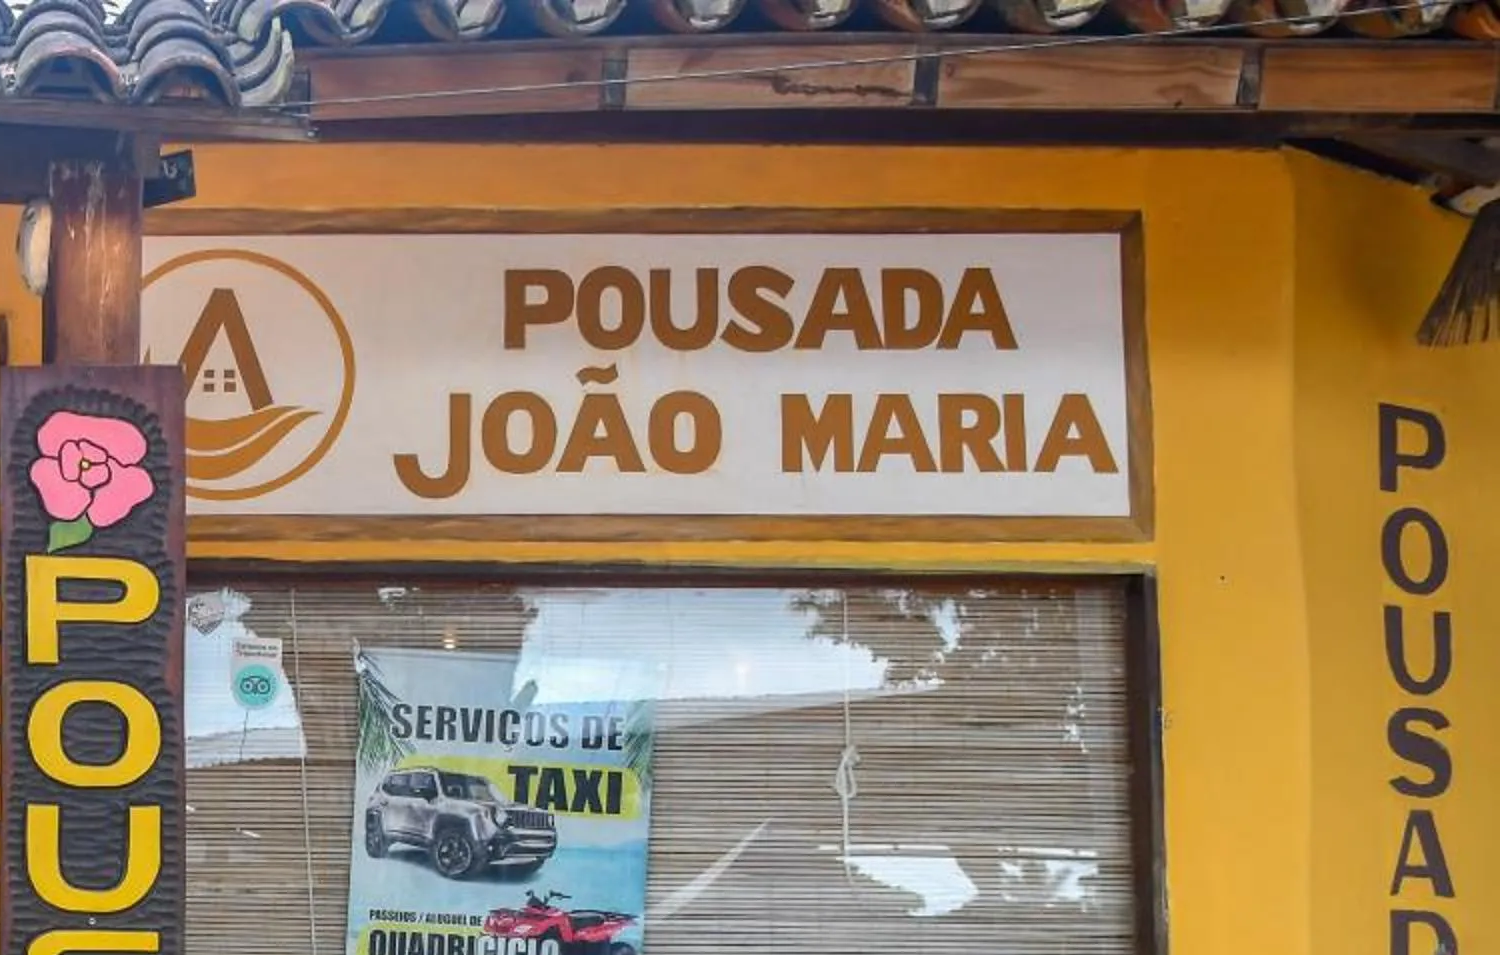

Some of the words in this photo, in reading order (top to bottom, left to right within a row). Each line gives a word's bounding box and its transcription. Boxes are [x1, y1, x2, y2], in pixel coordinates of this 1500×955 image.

[504, 265, 1019, 352] POUSADA
[393, 364, 723, 499] JOÃO
[780, 392, 1119, 474] MARIA
[391, 703, 569, 752] SERVIÇOS
[581, 715, 623, 750] DE
[507, 765, 623, 815] TAXI
[469, 915, 482, 926] DE
